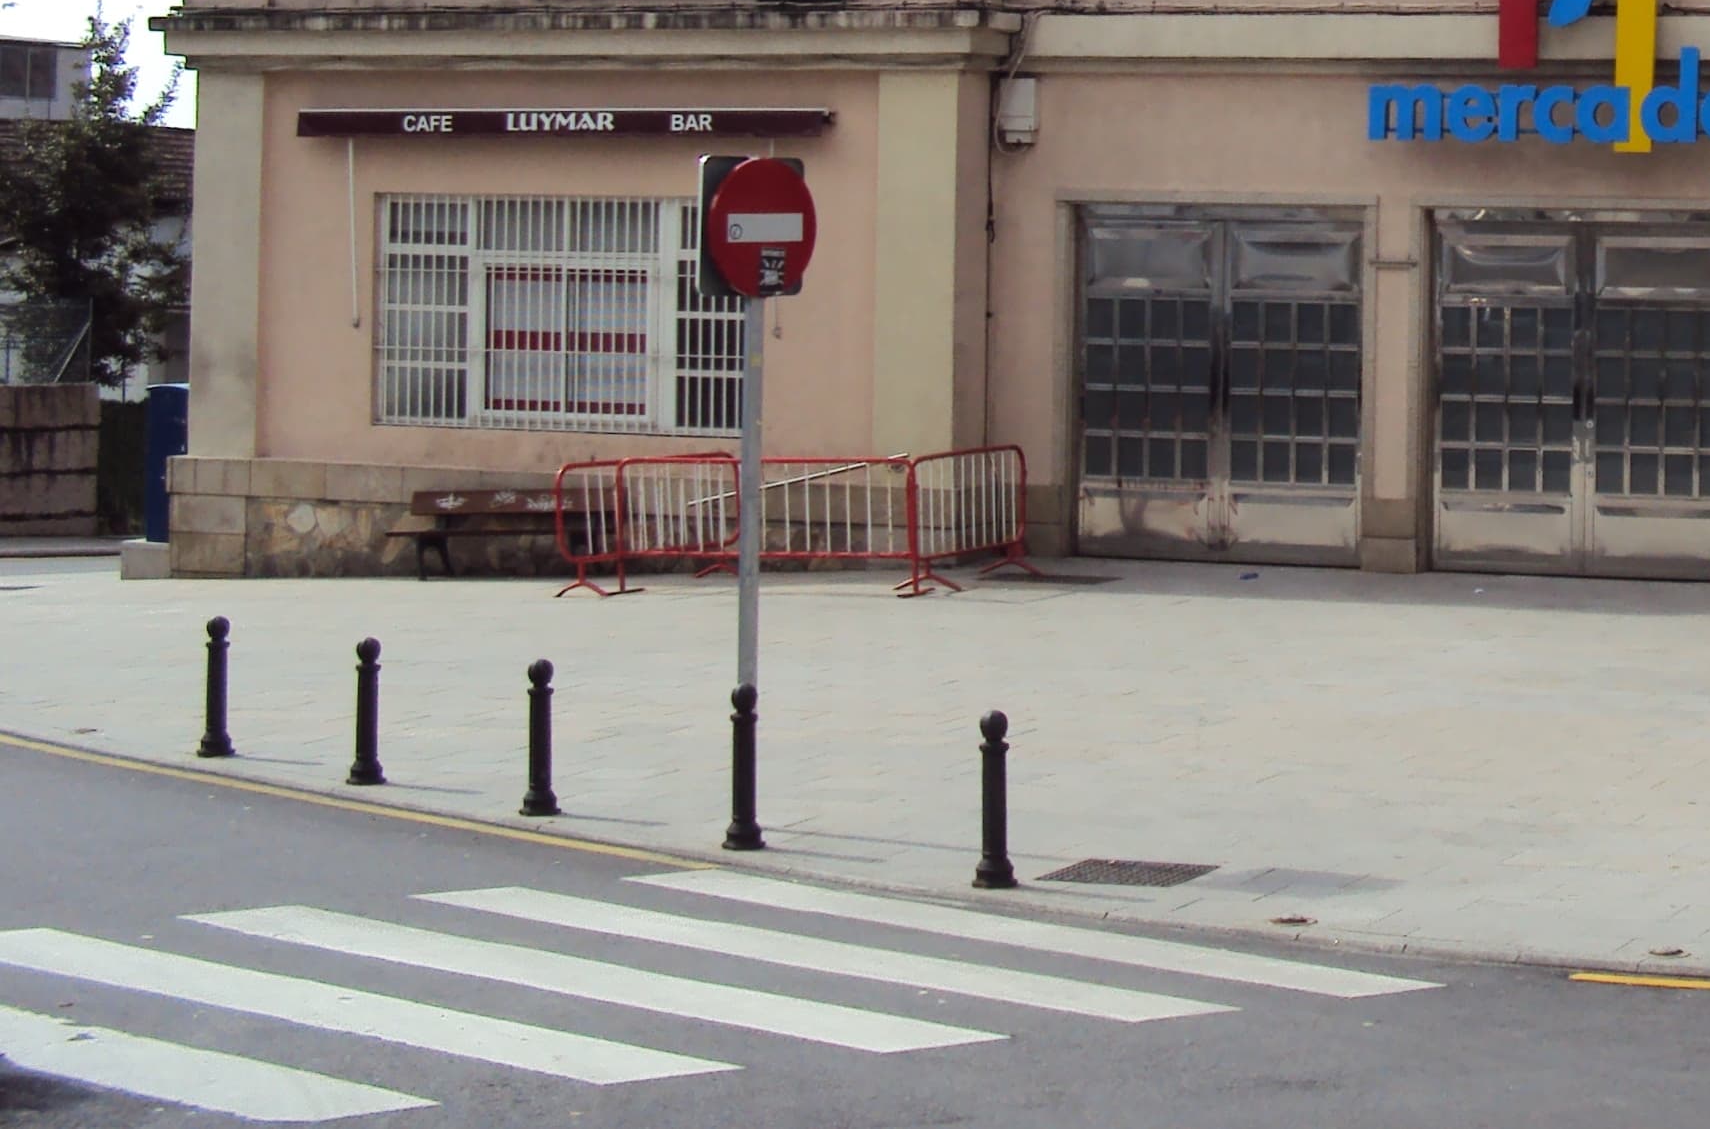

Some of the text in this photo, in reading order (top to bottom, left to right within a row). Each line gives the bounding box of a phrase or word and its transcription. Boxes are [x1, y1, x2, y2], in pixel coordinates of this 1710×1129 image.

[403, 112, 713, 132] CAFE LUYMAR BAR
